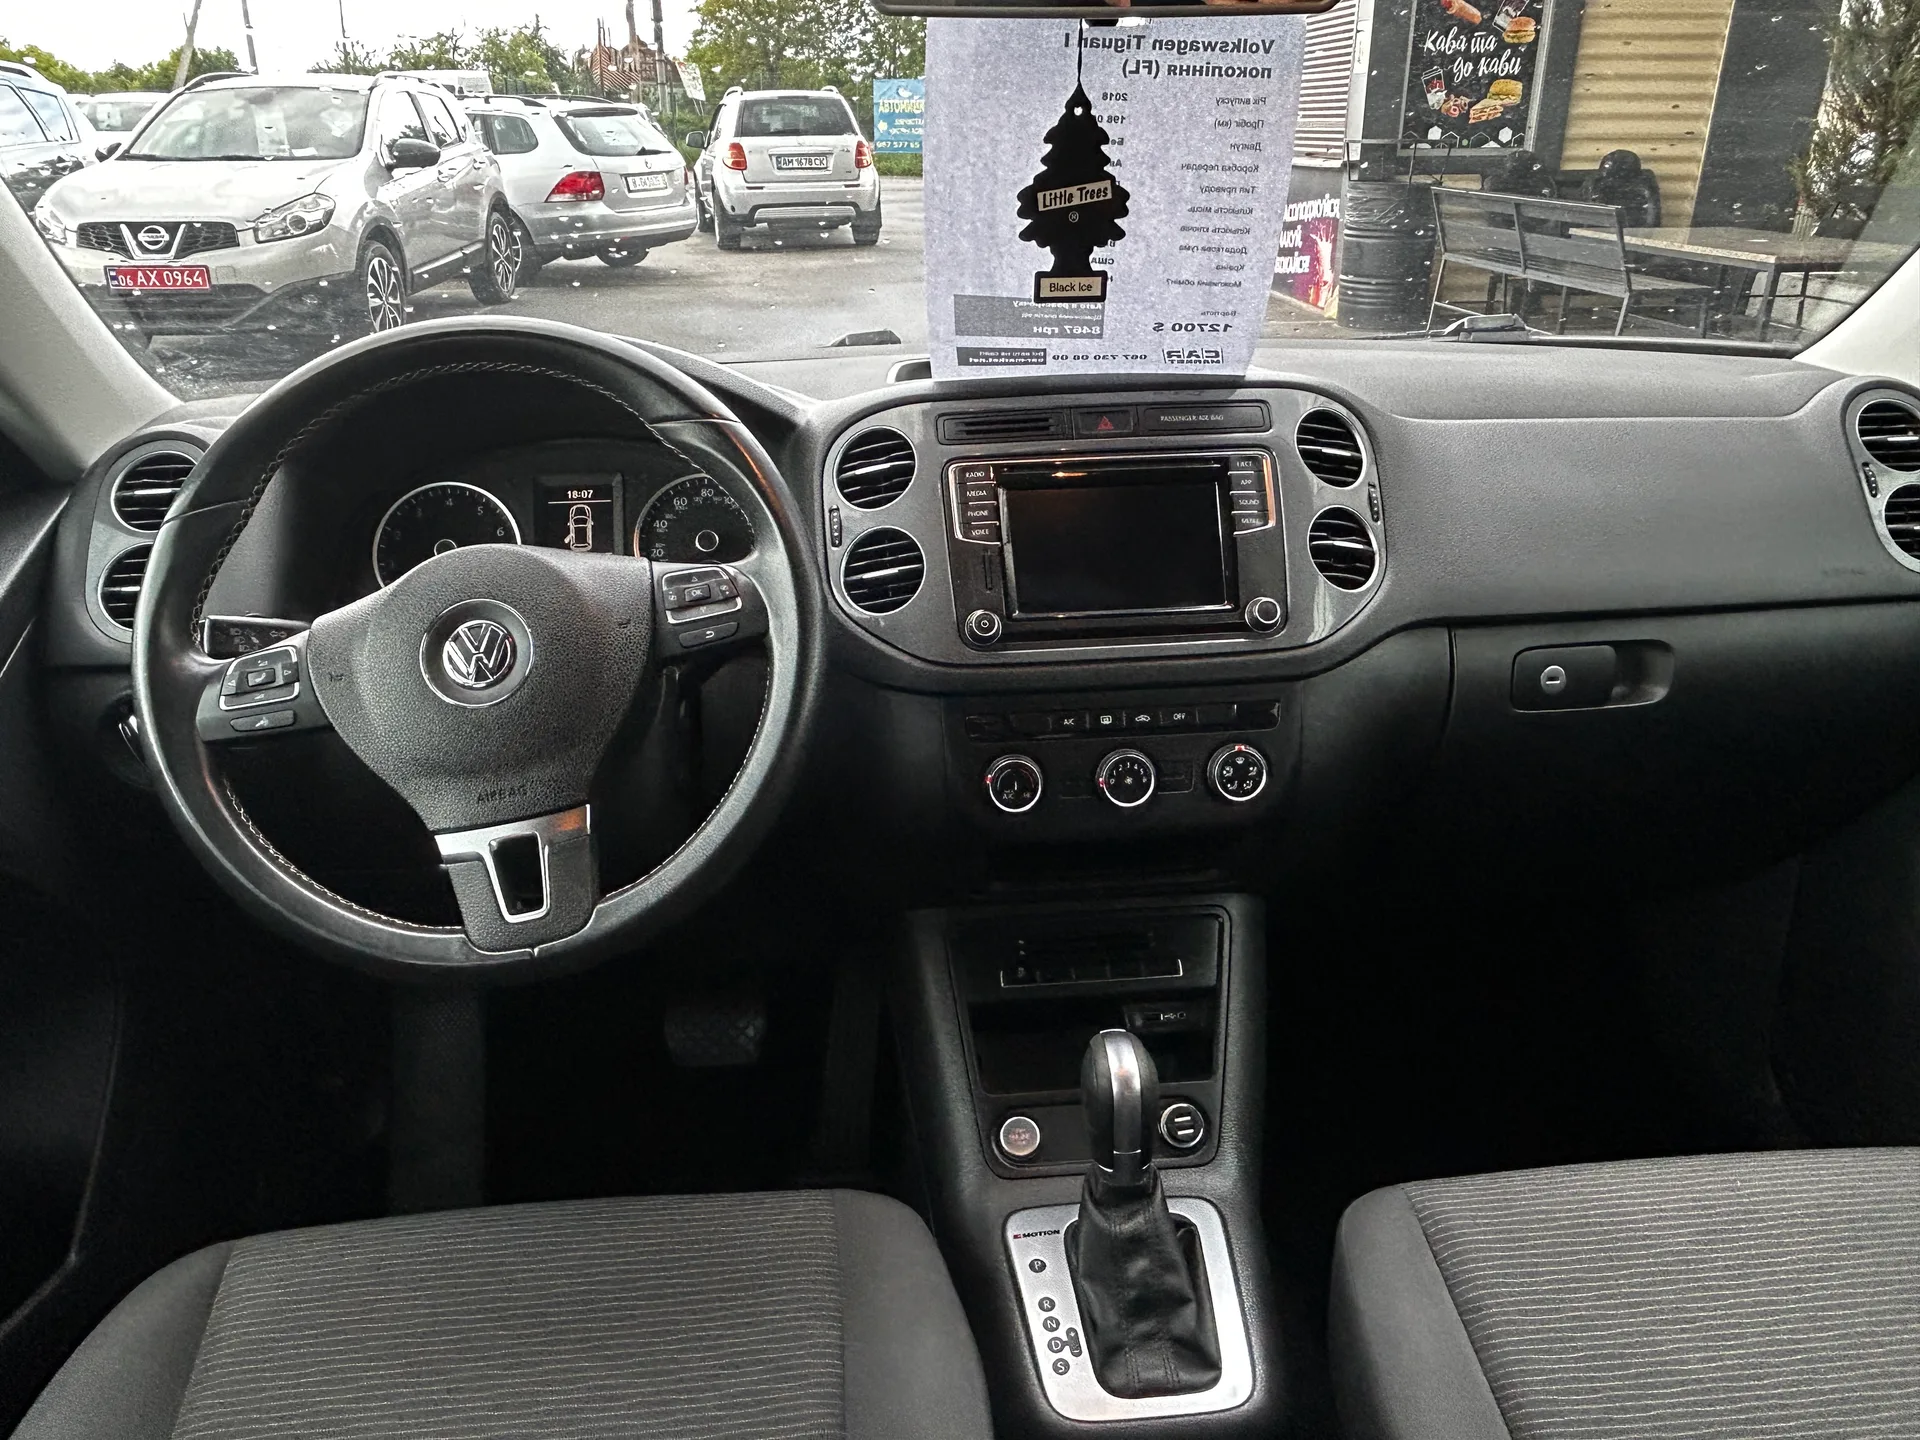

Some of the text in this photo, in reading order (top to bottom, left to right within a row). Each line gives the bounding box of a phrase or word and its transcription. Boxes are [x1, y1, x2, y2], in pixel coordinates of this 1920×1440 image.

[1423, 26, 1498, 55] Кава та
[1453, 48, 1521, 82] до кави
[814, 158, 825, 166] CK
[1042, 186, 1108, 209] Little Trees
[118, 270, 203, 286] 06 AX 0964
[1049, 282, 1093, 292] Black Ice
[567, 489, 593, 499] 18:07
[701, 488, 714, 497] 80
[673, 497, 688, 506] 60
[477, 506, 483, 515] 5
[653, 520, 668, 528] 40
[496, 527, 504, 536] 6
[1173, 712, 1185, 720] OFF
[1043, 1300, 1051, 1309] R
[1047, 1320, 1056, 1328] N
[1052, 1340, 1060, 1350] D
[1057, 1361, 1065, 1372] S
